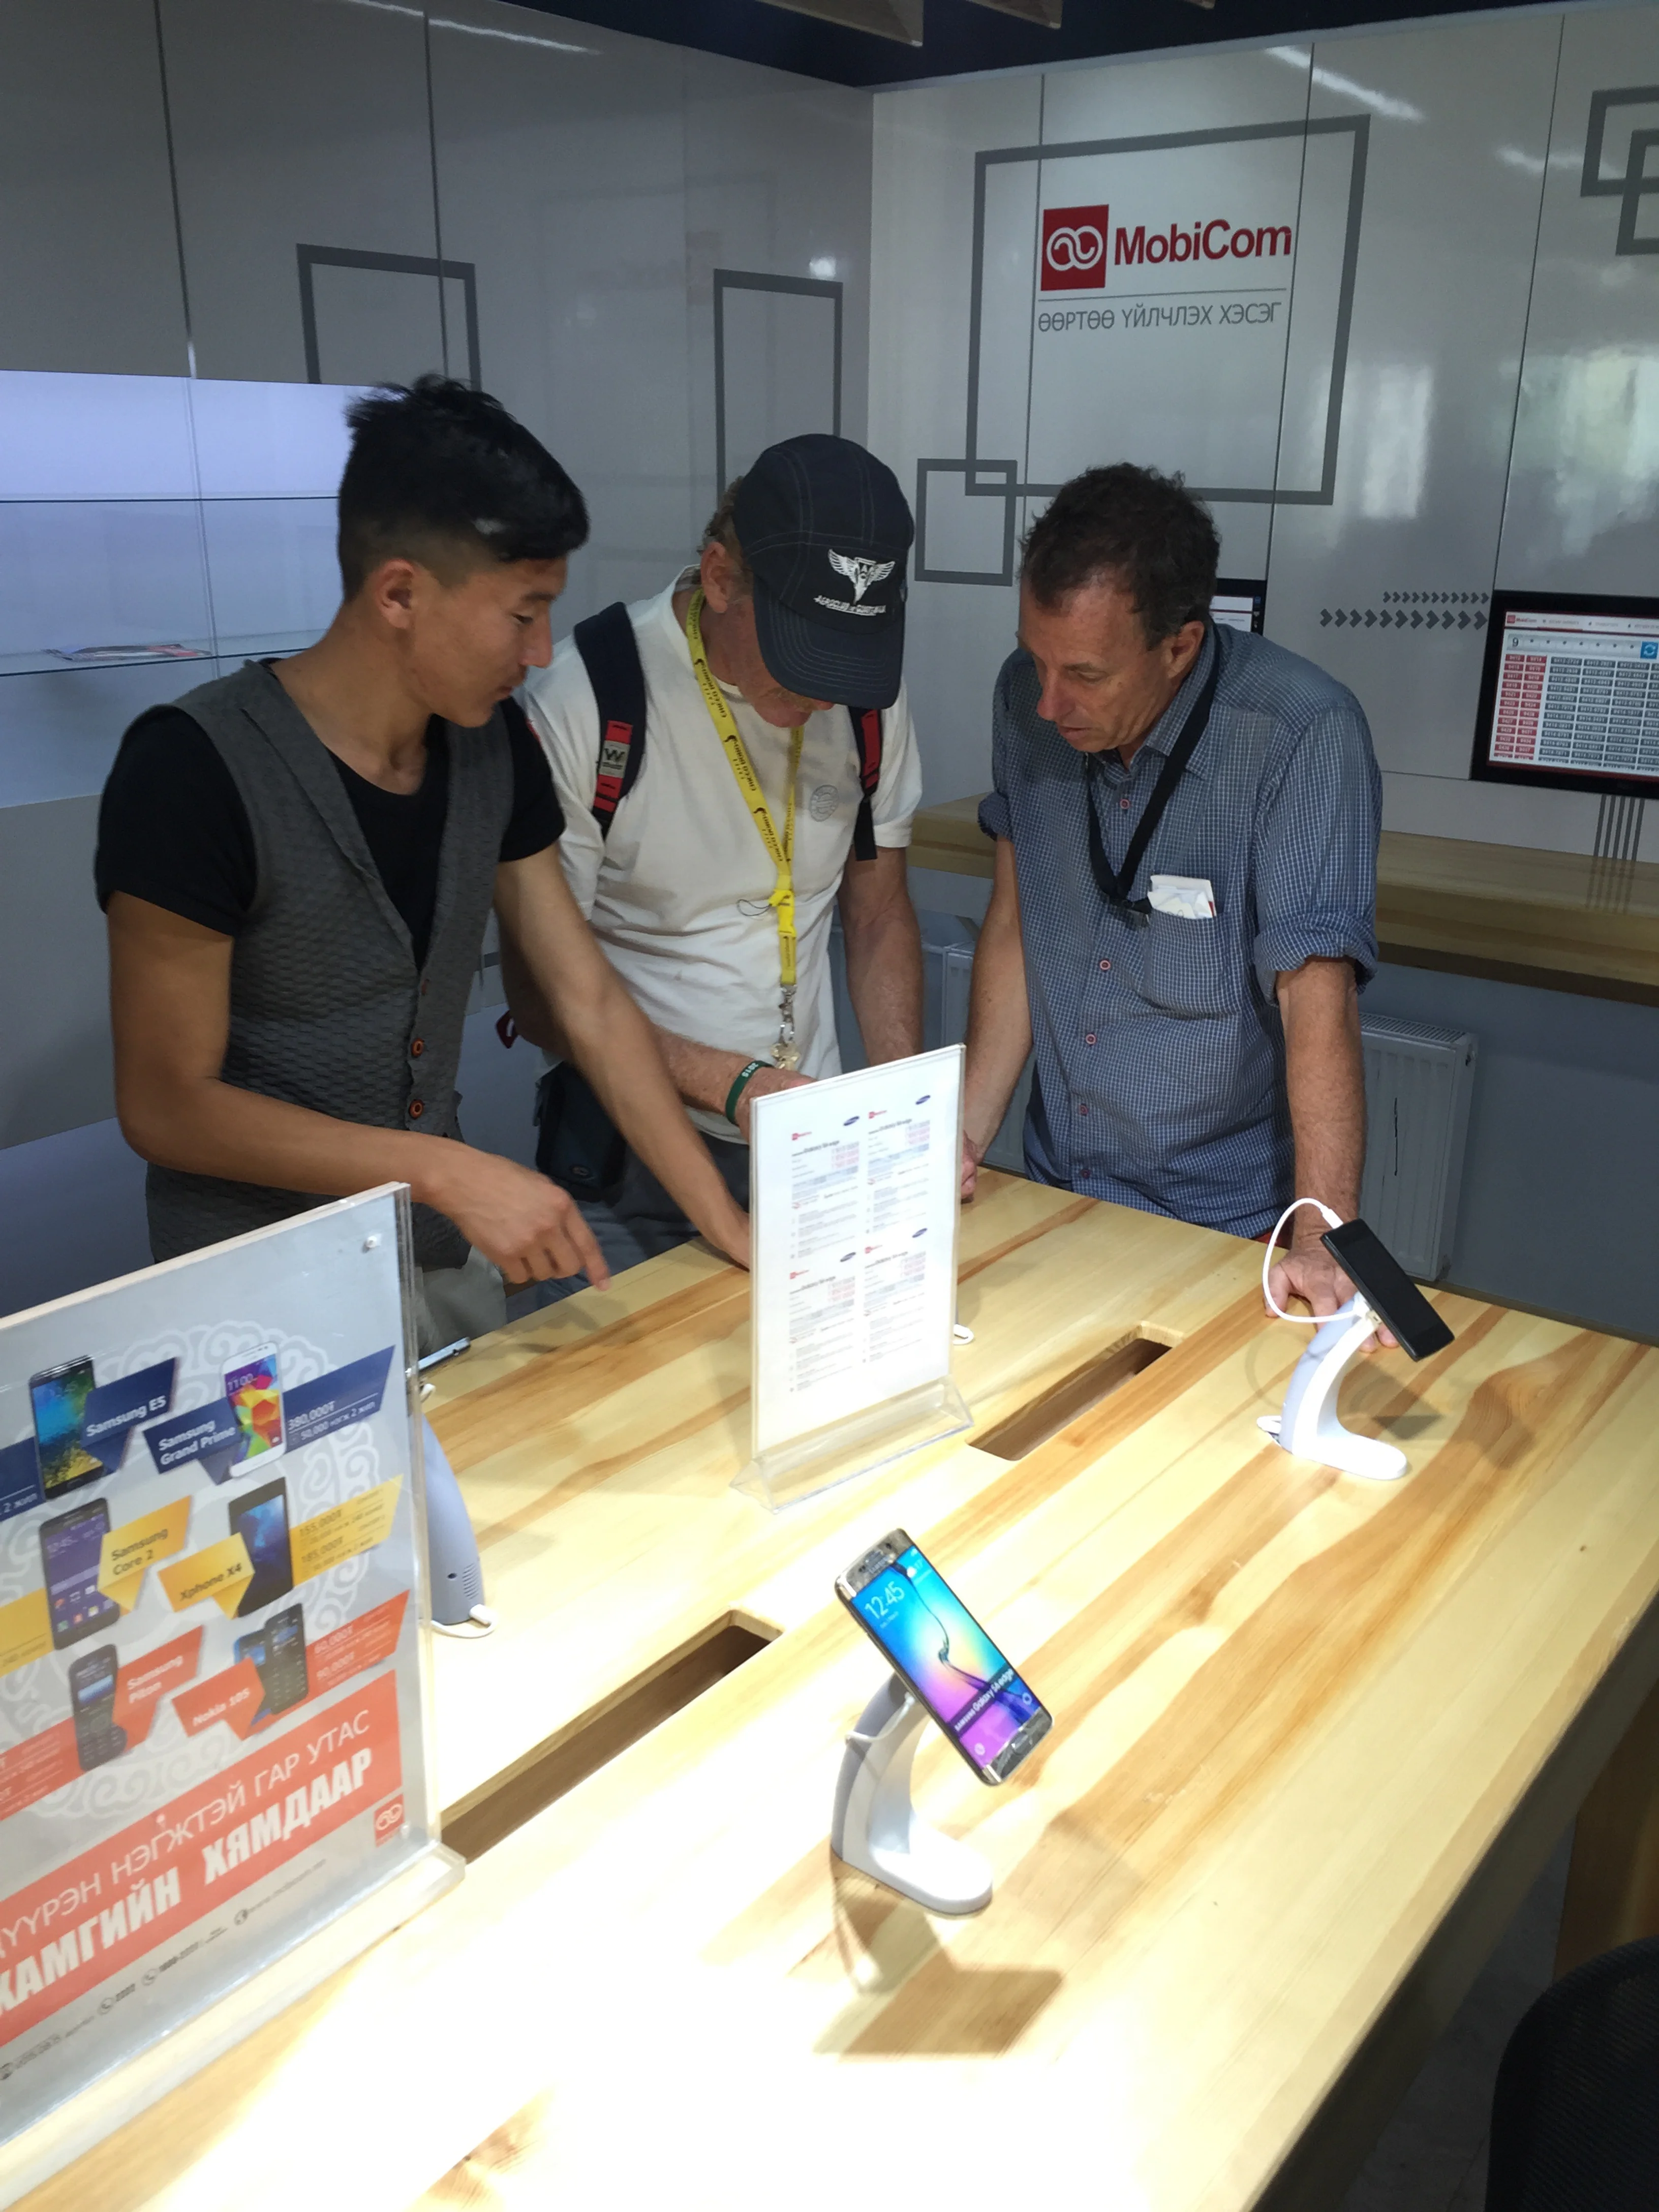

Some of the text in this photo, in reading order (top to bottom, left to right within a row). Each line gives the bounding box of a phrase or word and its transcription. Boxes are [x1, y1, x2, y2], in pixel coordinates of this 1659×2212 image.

[1114, 219, 1292, 266] MobiCom
[1038, 302, 1282, 332] ӨӨРТӨӨ ҮЙЛЧЛЭХ ХЭСЭГ
[1512, 637, 1519, 647] 9
[86, 1395, 167, 1438] Samsung E5
[159, 1419, 216, 1451] Samsung
[161, 1425, 236, 1466] Grand Prime
[111, 1528, 168, 1561] Samsung
[112, 1549, 154, 1577] Core 2
[179, 1562, 243, 1602] Xphone X4
[865, 1581, 906, 1620] 12:45
[127, 1655, 183, 1691] Samsung
[972, 1688, 995, 1714] Galaxy
[0, 1872, 102, 1958] ҮҮРЭН
[111, 1779, 247, 1884] НЭГЖТЭЙ
[255, 1753, 300, 1797] ГАР
[306, 1709, 370, 1765] УТАС
[202, 1747, 372, 1885] ХЯМДААР
